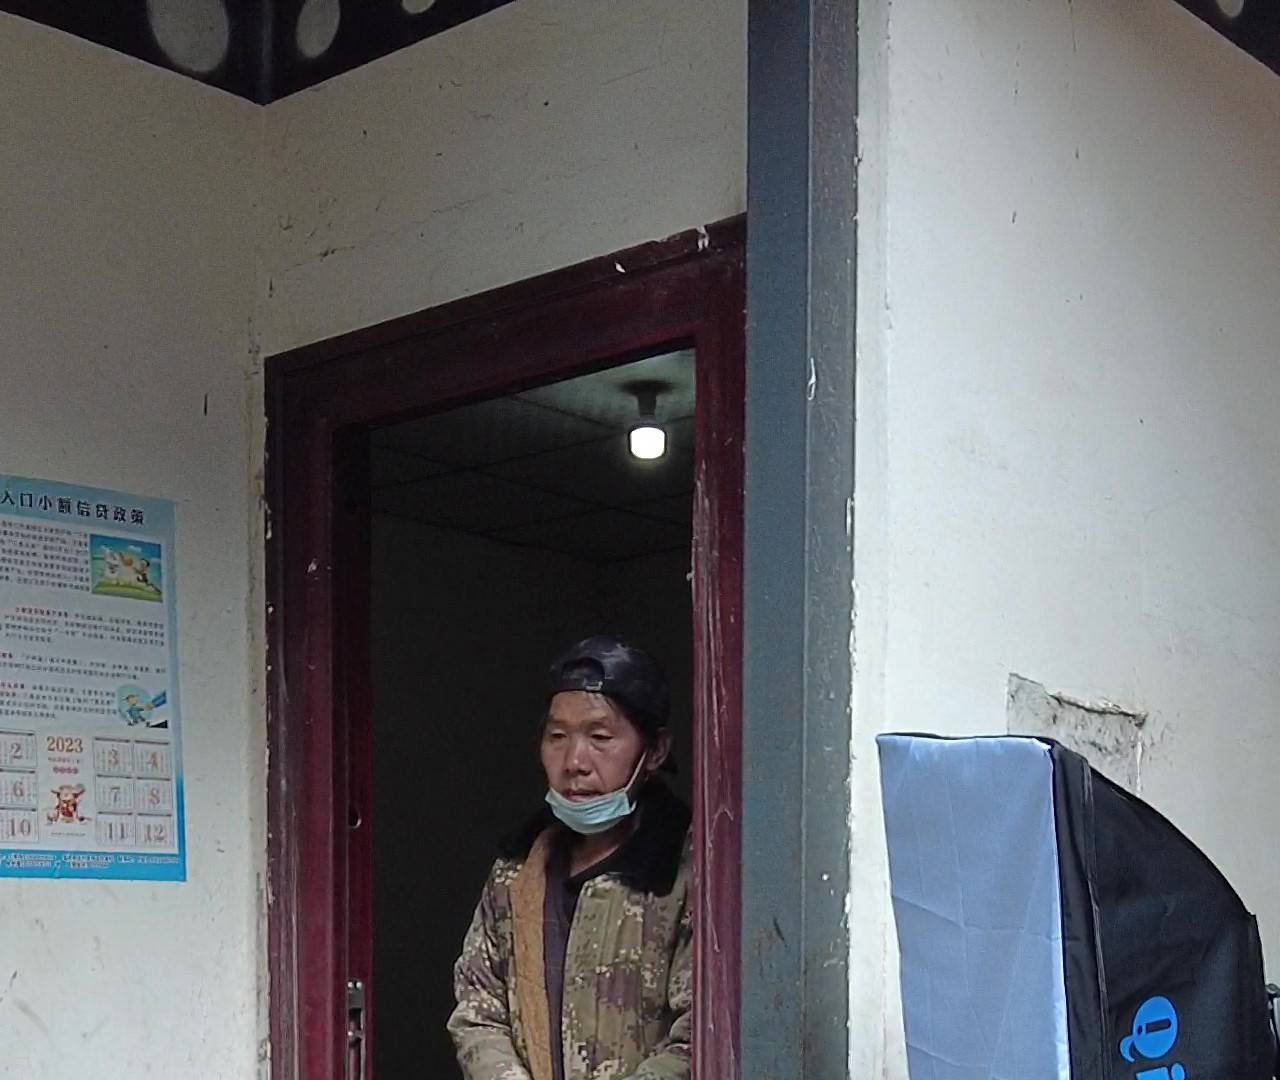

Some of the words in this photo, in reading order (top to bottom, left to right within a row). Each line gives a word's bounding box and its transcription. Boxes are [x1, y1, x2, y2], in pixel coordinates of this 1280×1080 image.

[10, 742, 22, 759] 2
[46, 736, 83, 753] 2023
[108, 749, 119, 765] 3
[147, 752, 159, 769] 4
[12, 781, 23, 797] 6
[110, 786, 121, 801] 7
[149, 789, 160, 805] 8
[9, 818, 31, 836] 10
[107, 823, 126, 840] 11
[145, 825, 164, 841] 12
